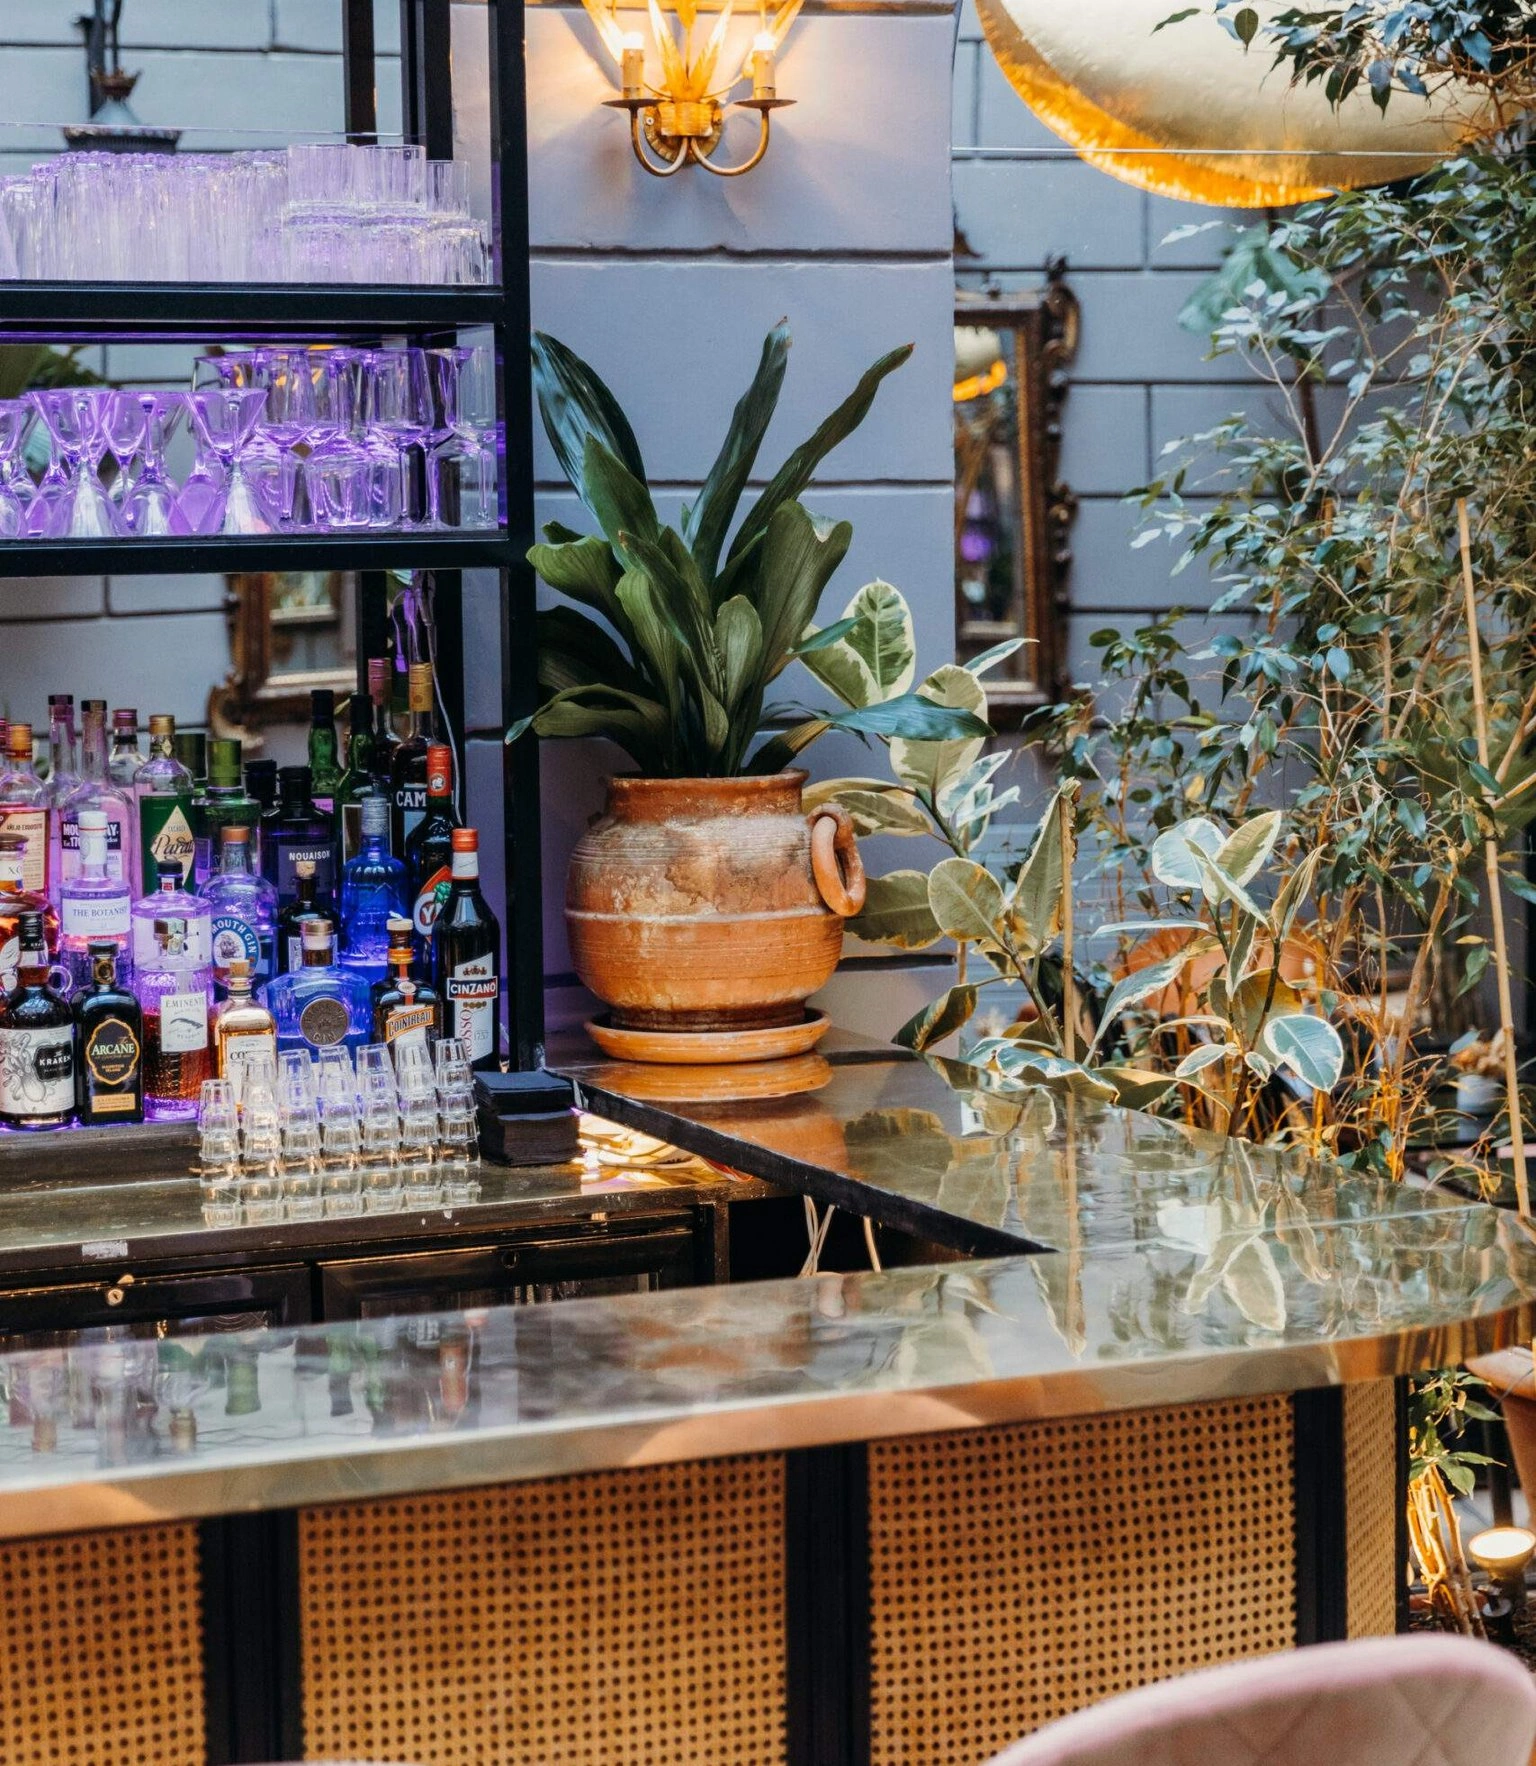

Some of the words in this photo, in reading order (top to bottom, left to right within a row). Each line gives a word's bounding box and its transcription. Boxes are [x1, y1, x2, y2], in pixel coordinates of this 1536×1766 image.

[396, 790, 427, 808] CAM
[288, 850, 331, 861] NOUAISON
[73, 908, 89, 917] THE
[91, 905, 128, 917] BOTANIST
[212, 919, 247, 935] MOUTH
[244, 933, 258, 954] GIN
[449, 982, 497, 996] CINZANO
[387, 1009, 431, 1037] COINTREAU
[91, 1042, 136, 1056] ARCANE
[39, 1054, 72, 1067] KRAKEN
